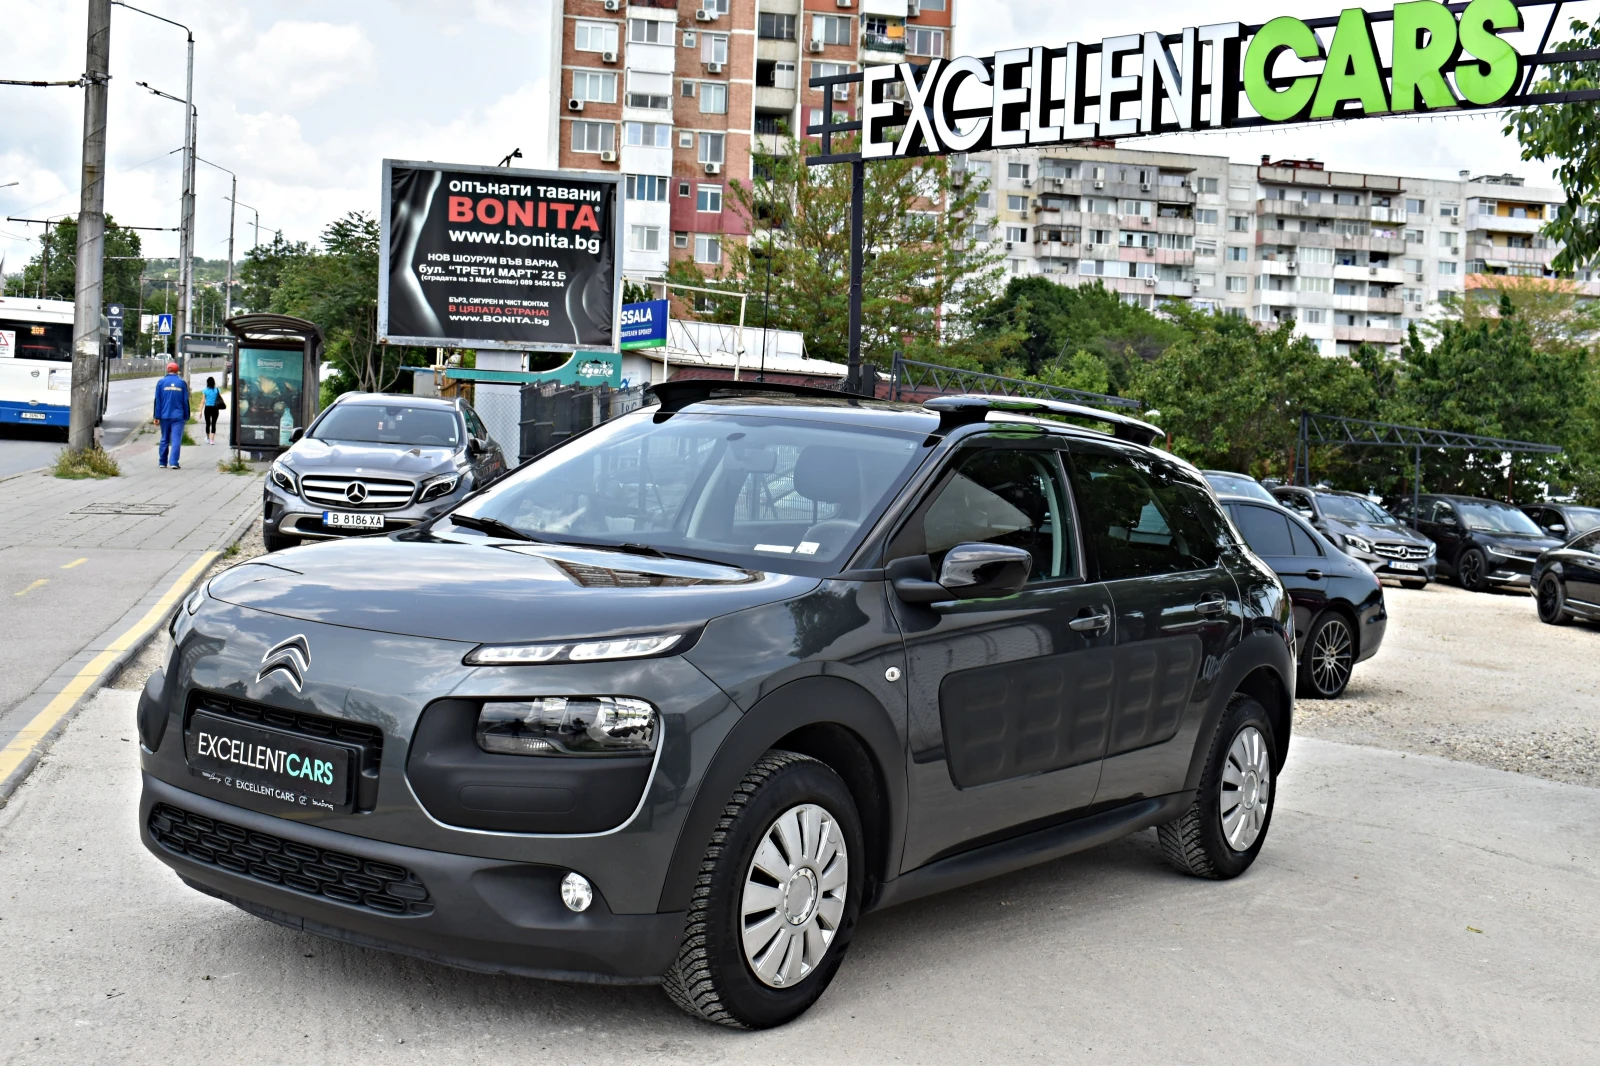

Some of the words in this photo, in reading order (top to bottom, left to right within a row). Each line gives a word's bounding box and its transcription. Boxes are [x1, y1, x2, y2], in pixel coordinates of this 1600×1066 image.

[449, 180, 531, 197] опънати
[537, 186, 600, 202] тавани
[448, 196, 599, 231] BONITA
[449, 230, 600, 253] www.bonita.bg
[428, 253, 450, 261] НОВ
[453, 254, 497, 264] ШОУРУМ
[500, 257, 522, 266] ВЪВ
[525, 258, 559, 268] ВАРНА
[418, 264, 445, 275] бул.
[541, 270, 555, 280] 22
[558, 271, 566, 280] Б
[421, 274, 457, 282] (сградата
[493, 277, 519, 286] Center)
[449, 296, 468, 304] БЪРЗ,
[469, 297, 498, 305] СИГУРЕН
[459, 305, 502, 314] ЦЯЛАТА
[504, 307, 549, 316] СТРАНА!
[449, 315, 549, 326] www.BONITA.bg
[332, 513, 339, 524] B
[344, 514, 367, 525] 8186
[369, 515, 382, 526] XA
[236, 780, 274, 797] EXCELLENT
[275, 789, 295, 802] CARS
